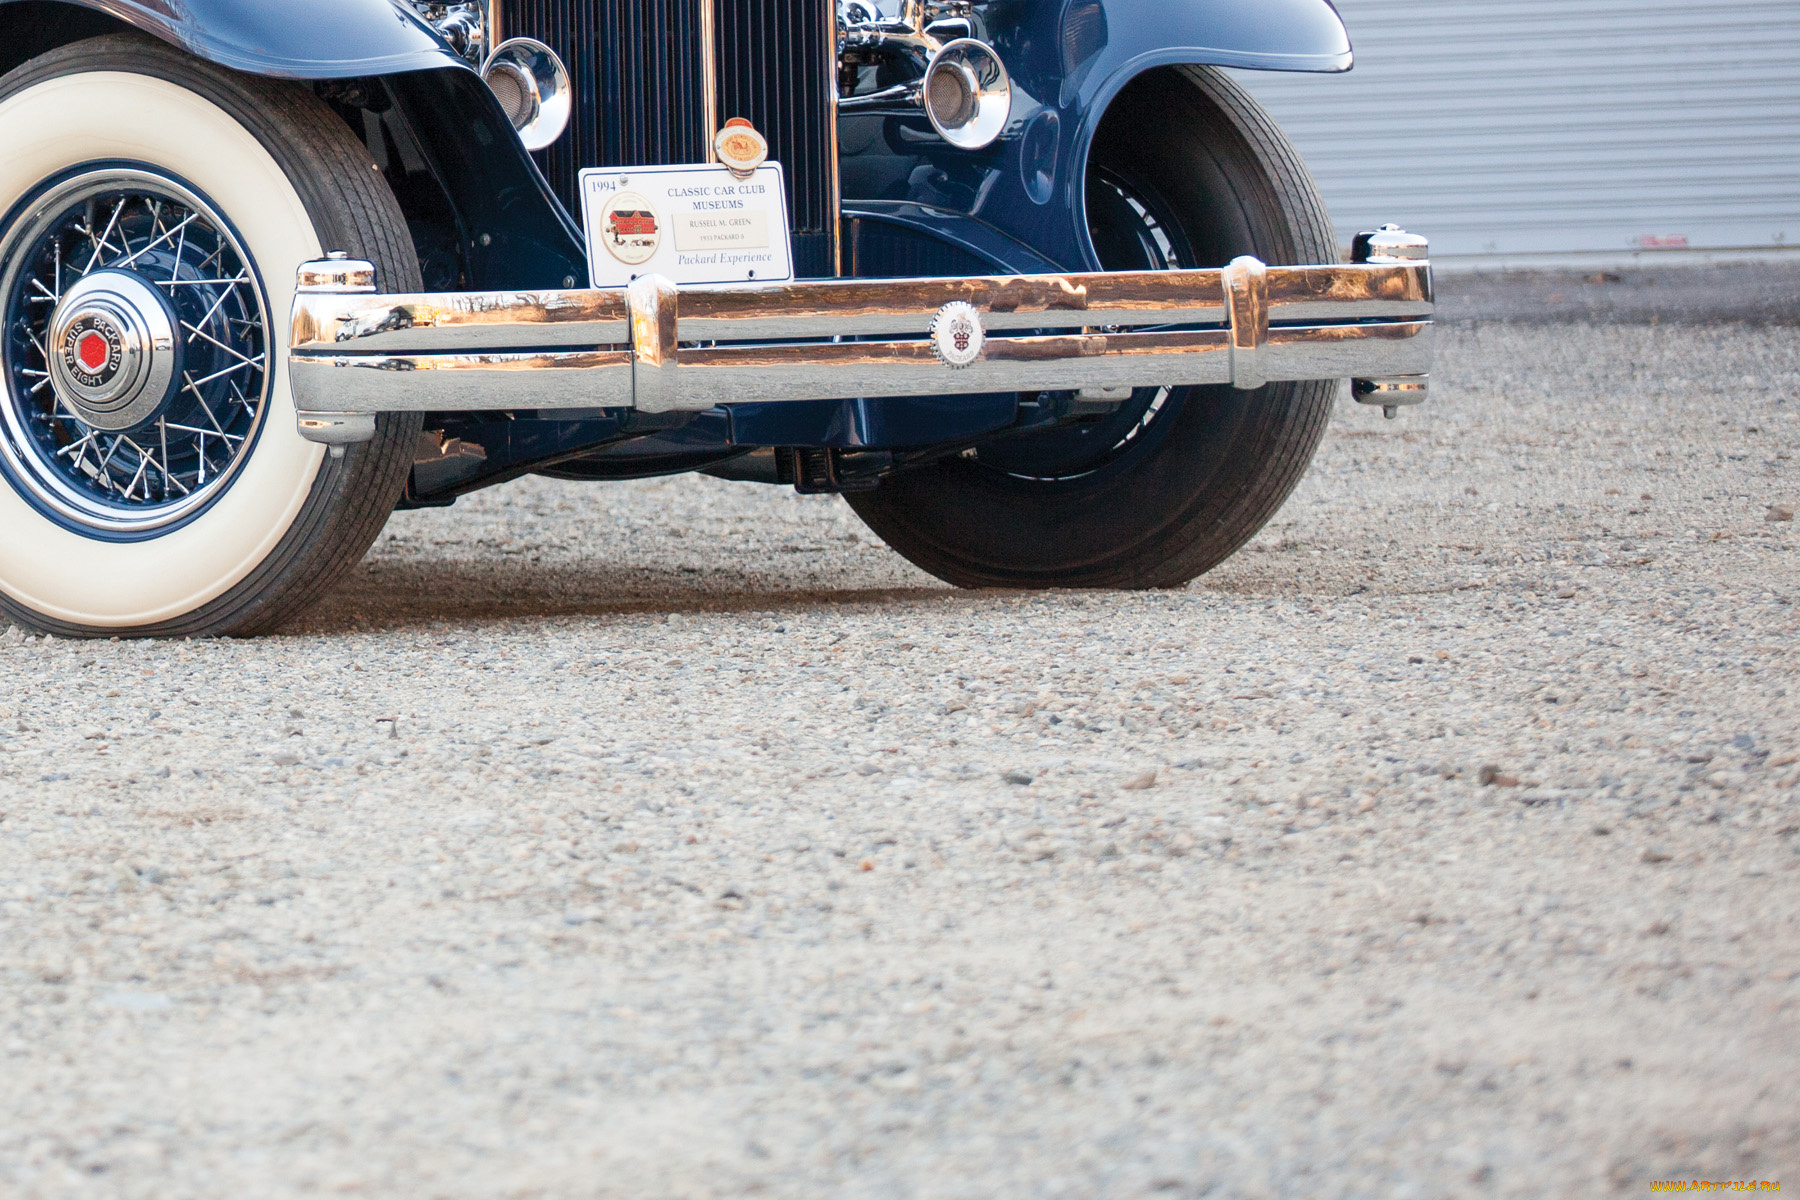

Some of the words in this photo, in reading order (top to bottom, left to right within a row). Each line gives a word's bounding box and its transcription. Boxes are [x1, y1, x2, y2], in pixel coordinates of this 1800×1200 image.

[592, 180, 616, 192] 1994
[667, 186, 712, 198] CLASSIC
[714, 185, 735, 196] CAR
[738, 184, 766, 195] CLUB
[692, 200, 744, 210] MUSEUMS
[689, 219, 717, 228] RUSSELL
[718, 219, 728, 227] M.
[728, 218, 752, 227] GREEN
[678, 254, 717, 265] Packard
[720, 252, 772, 265] Experience
[65, 322, 84, 364] SUPER
[93, 318, 122, 371] PACKARD
[70, 365, 103, 386] EIGHT
